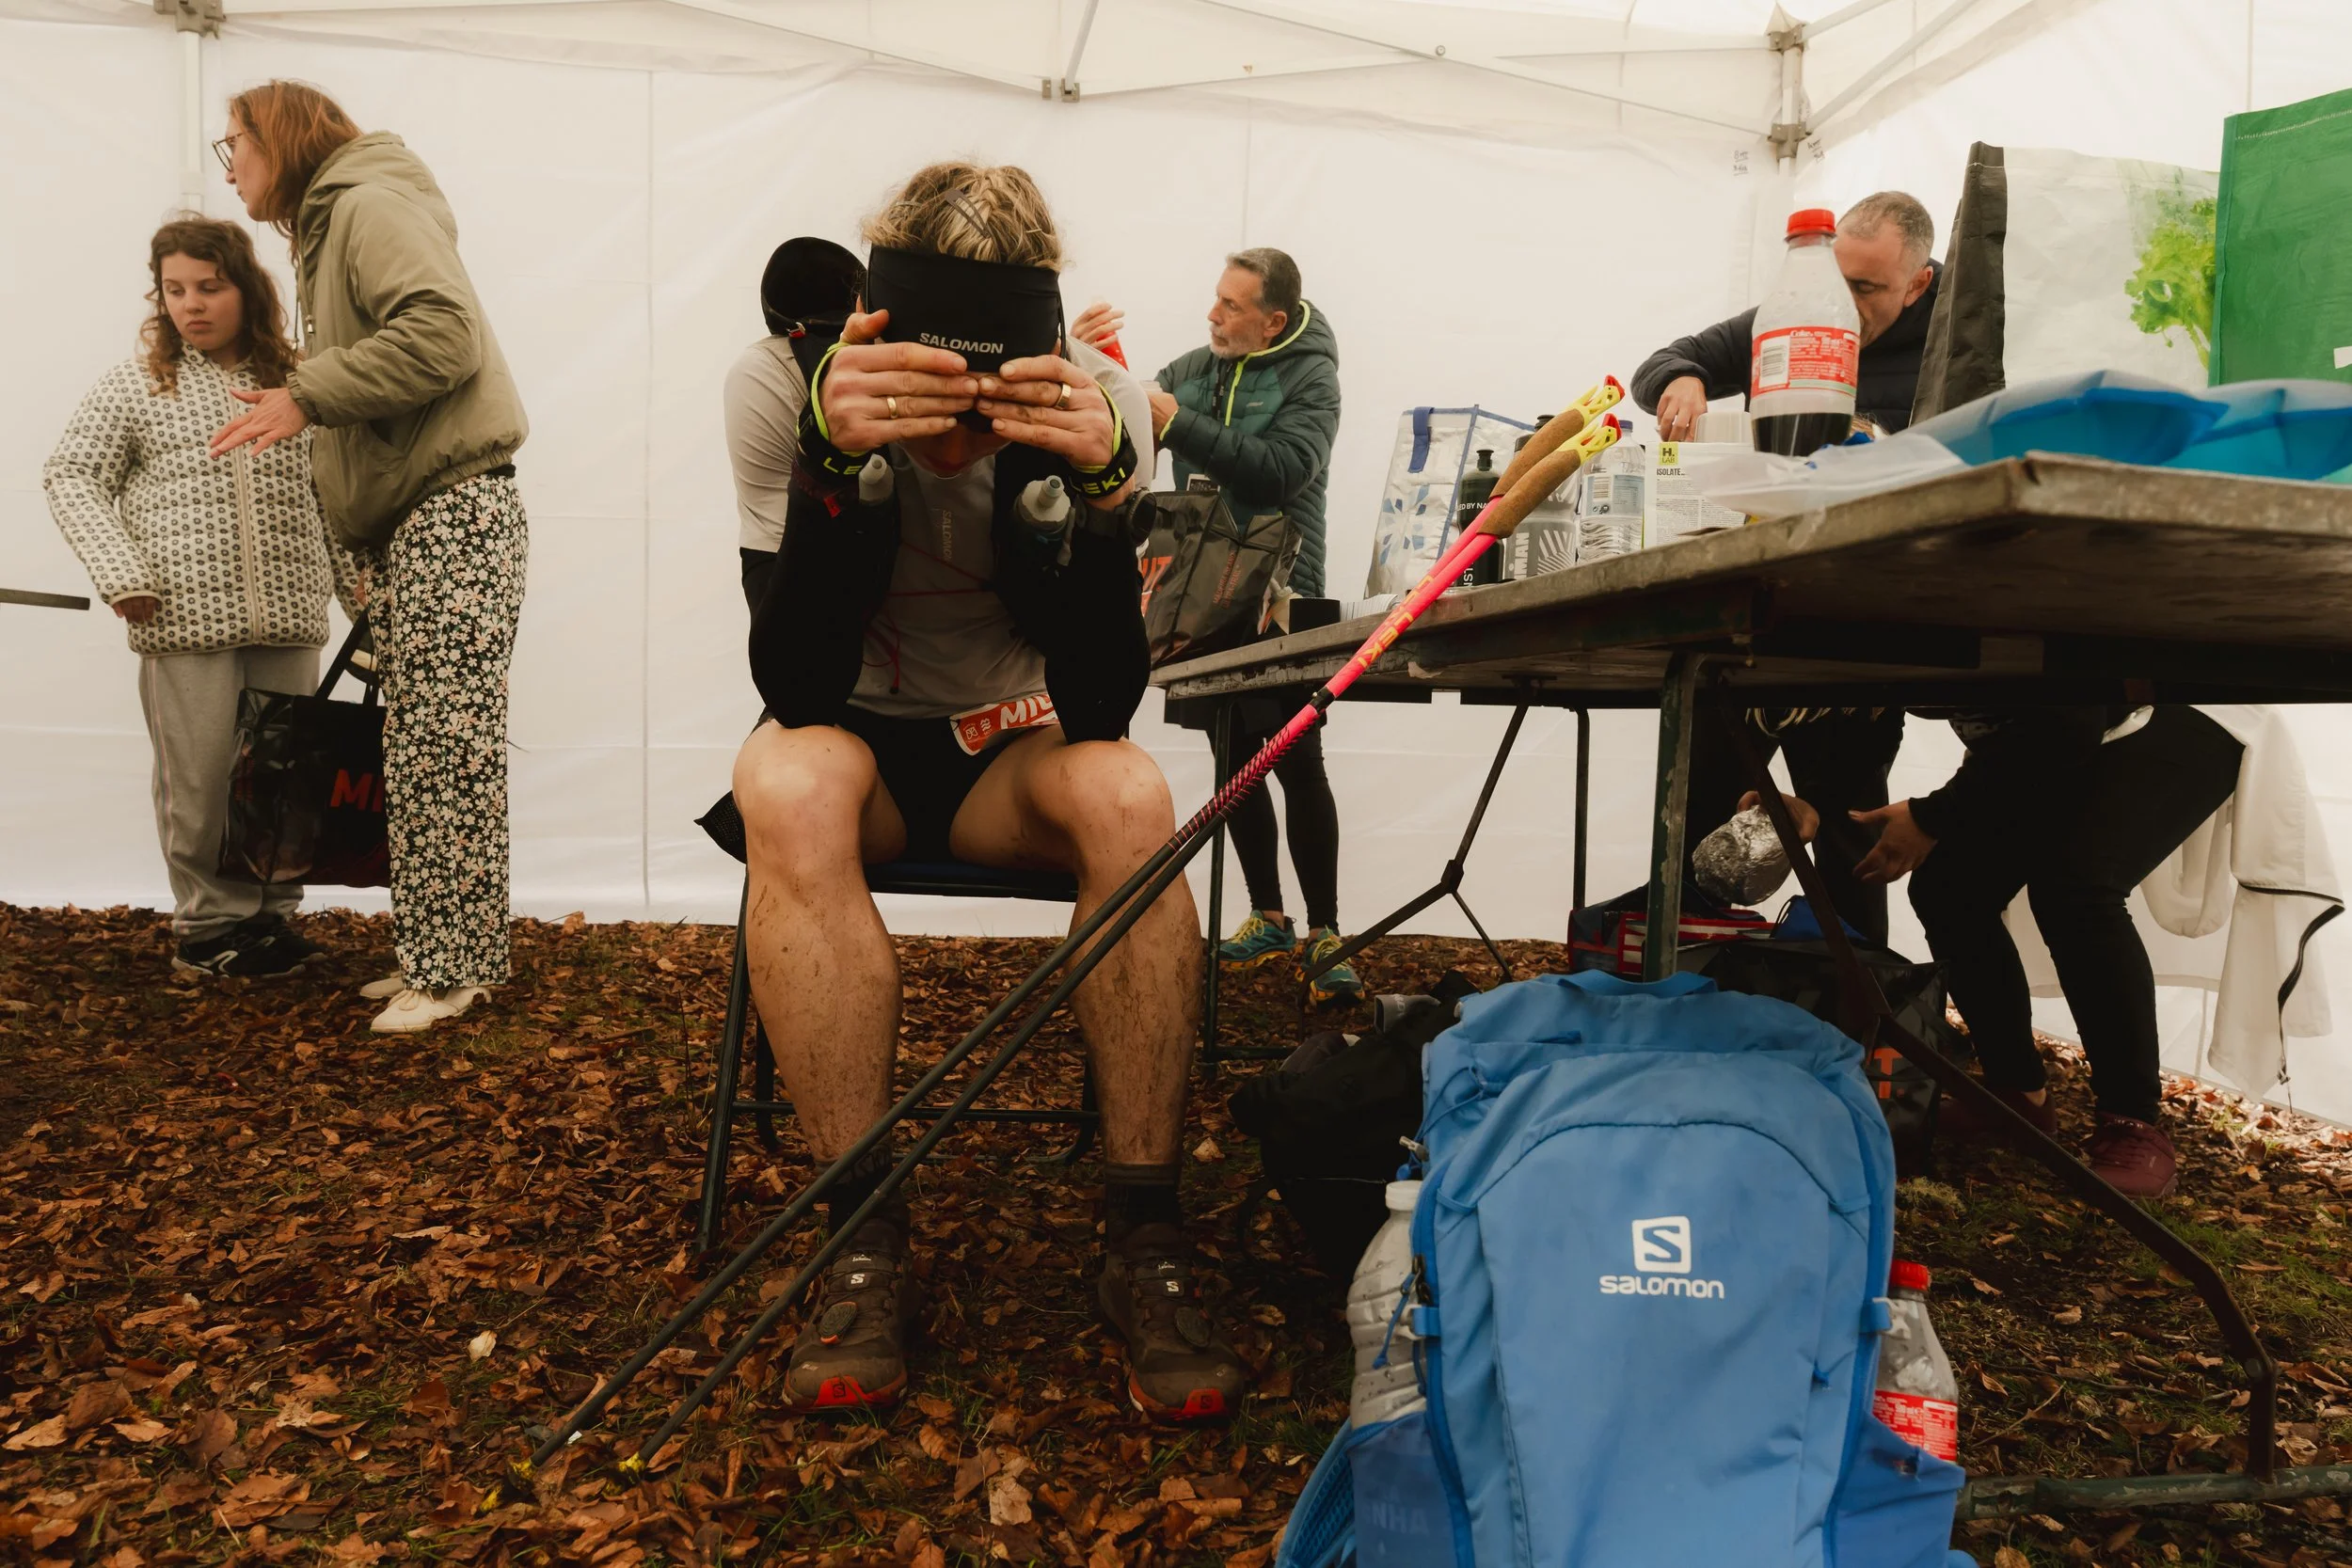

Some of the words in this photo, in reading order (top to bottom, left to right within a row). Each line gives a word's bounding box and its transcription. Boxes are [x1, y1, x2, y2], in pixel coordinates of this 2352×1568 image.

[919, 332, 1004, 354] SALOMON
[1661, 448, 1676, 456] H.
[1082, 467, 1126, 494] EKI
[1357, 611, 1414, 668] LEKI
[1598, 1275, 1725, 1300] salomon
